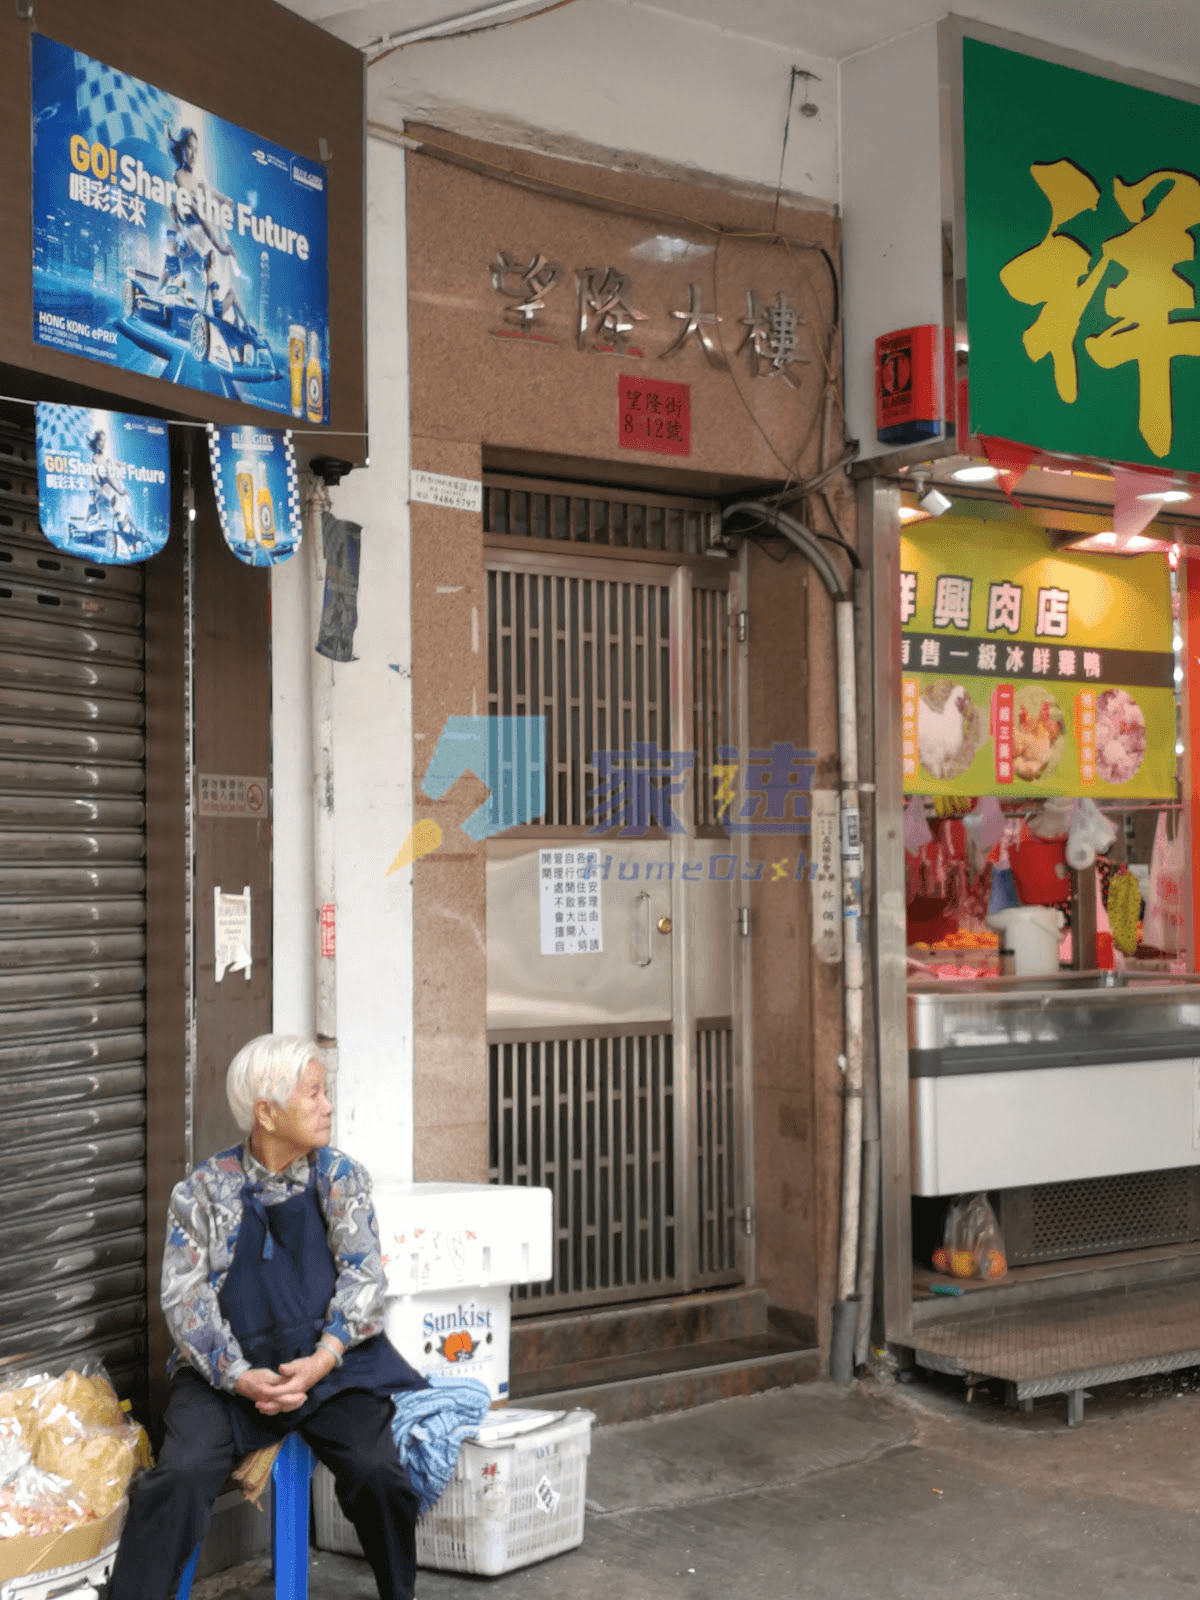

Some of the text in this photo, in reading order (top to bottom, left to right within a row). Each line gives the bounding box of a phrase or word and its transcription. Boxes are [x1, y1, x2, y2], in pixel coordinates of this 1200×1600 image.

[70, 134, 310, 261] GO! Share the Future
[39, 311, 118, 345] HONG KONG ePRIX
[487, 251, 811, 389] 望隆大樓
[625, 390, 683, 418] 望隆街
[44, 455, 68, 473] GO!
[68, 457, 107, 477] Share
[127, 463, 166, 484] Future
[422, 1303, 492, 1338] Sunkist
